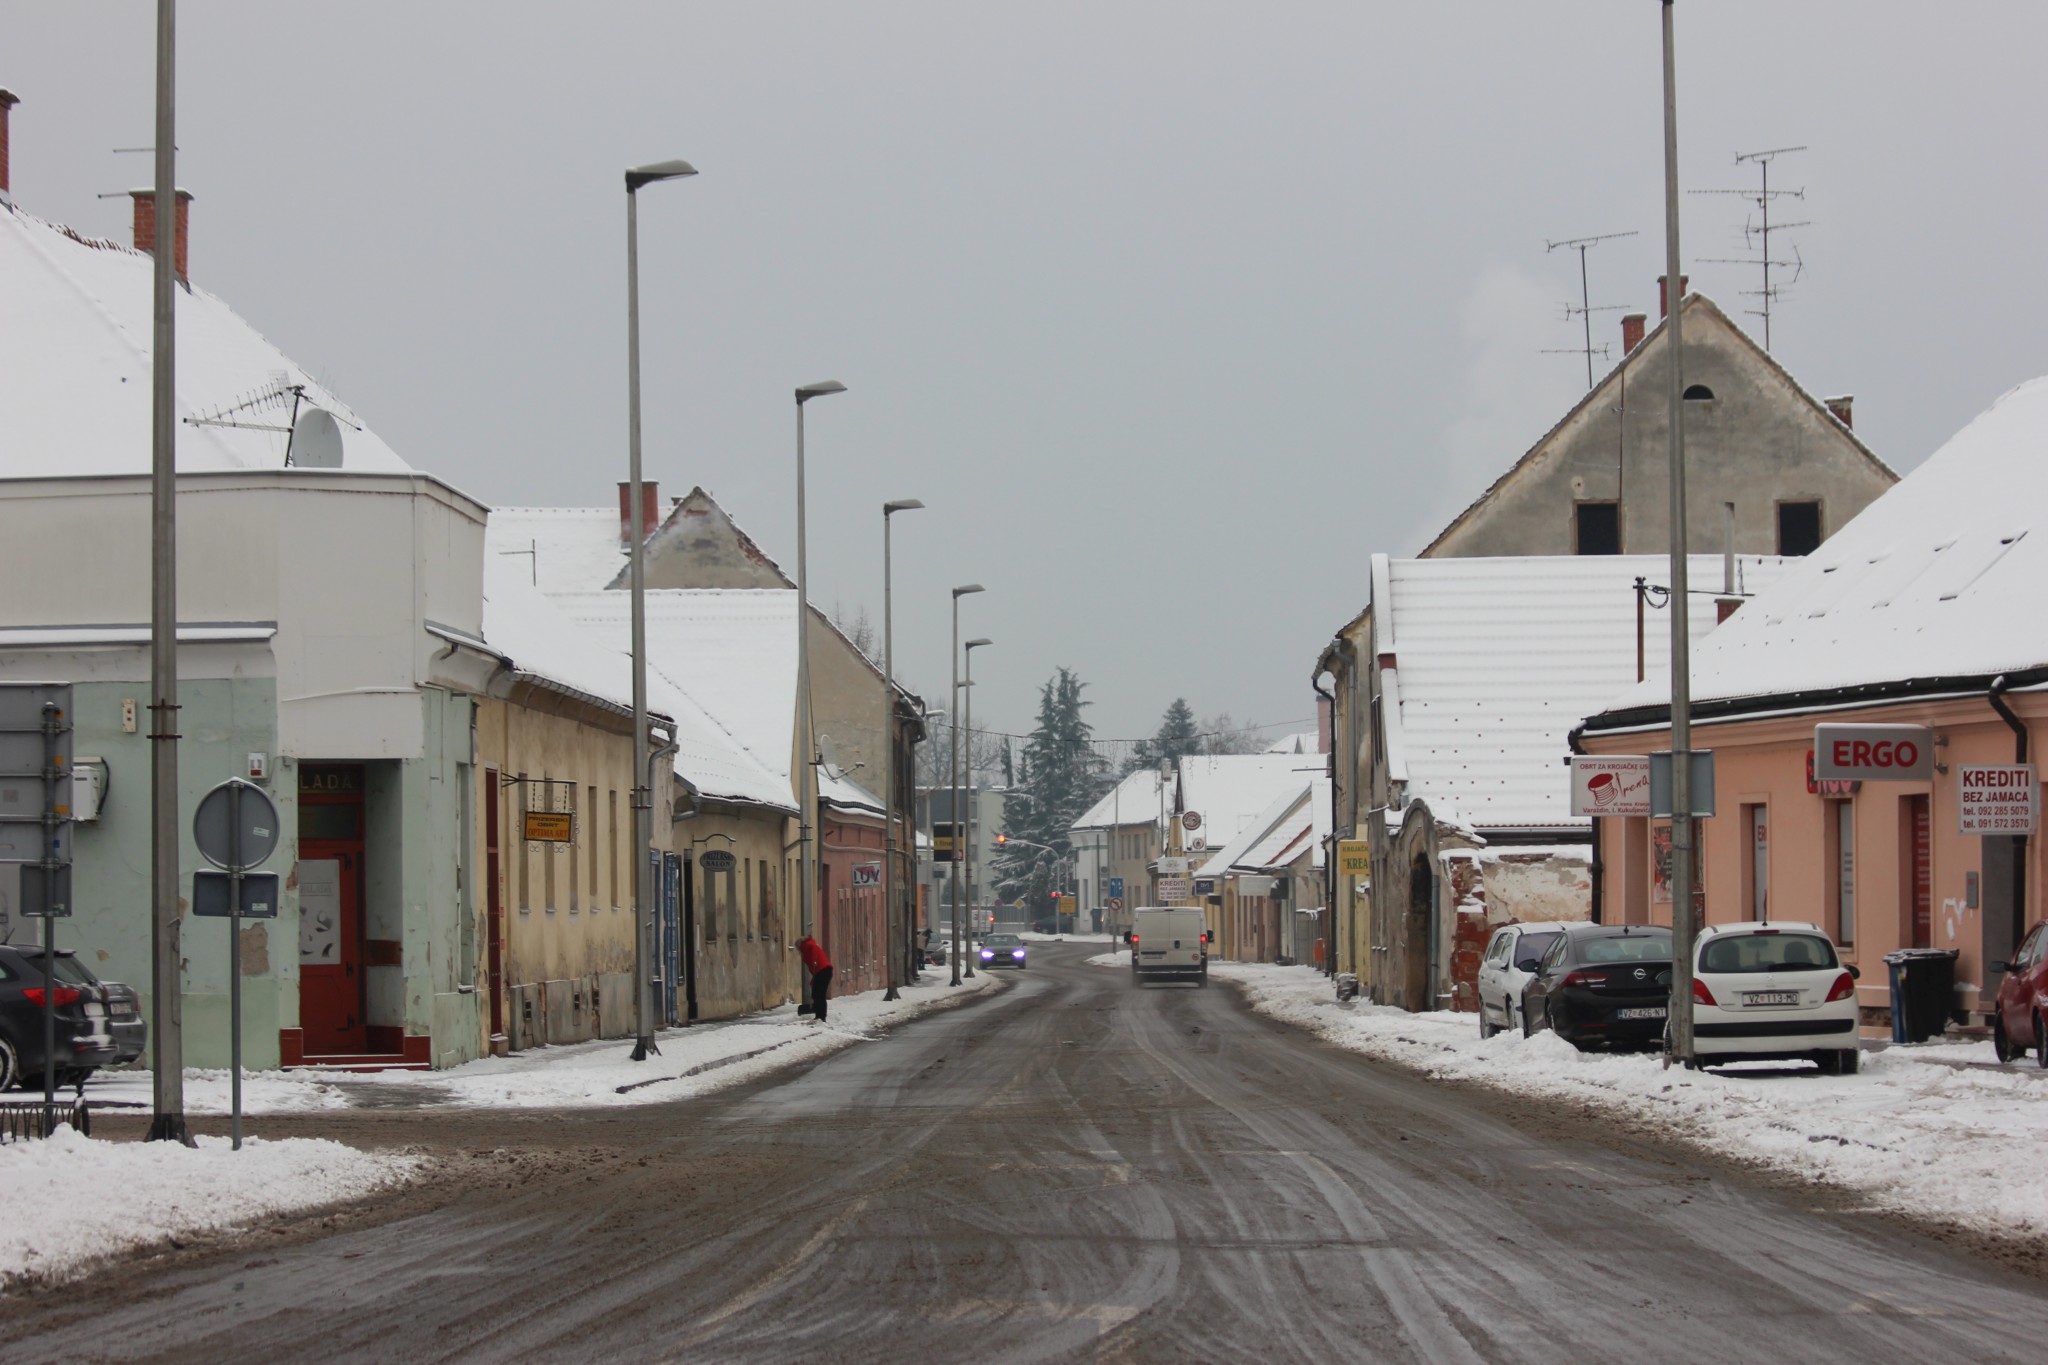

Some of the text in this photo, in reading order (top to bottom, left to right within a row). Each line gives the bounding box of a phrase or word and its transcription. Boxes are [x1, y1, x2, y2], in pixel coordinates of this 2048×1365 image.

[1833, 740, 1919, 768] ERGO
[1607, 761, 1638, 770] KROJAČKE
[1963, 770, 2029, 787] KREDITI
[1963, 791, 2029, 802] BEZ JAMACA
[1963, 806, 2029, 816] tel. 092 285 5079
[1963, 819, 2029, 828] tel. 091 572 3570
[1749, 994, 1760, 1003] VZ
